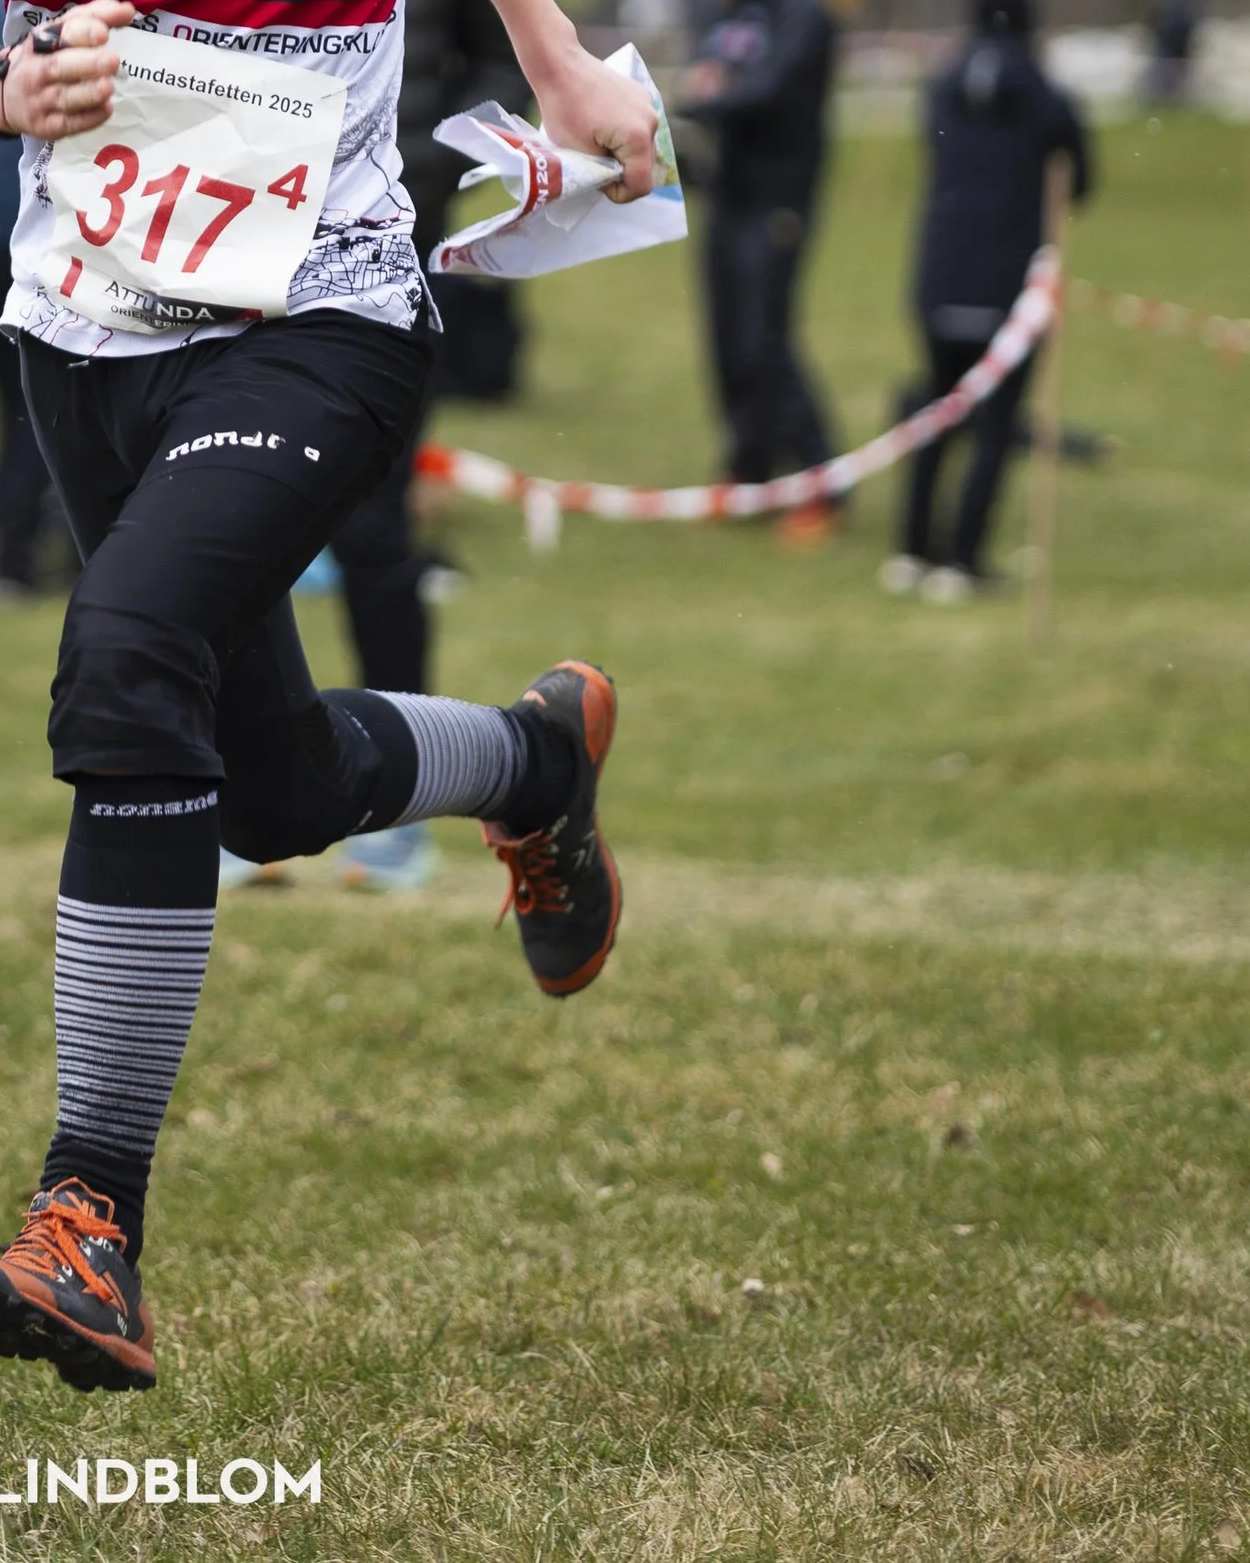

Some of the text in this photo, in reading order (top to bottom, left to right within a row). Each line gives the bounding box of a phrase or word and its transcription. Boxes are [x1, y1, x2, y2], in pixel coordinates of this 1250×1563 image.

[268, 94, 313, 119] 2025
[76, 144, 309, 273] 317 4
[105, 280, 215, 320] ATTUNDA
